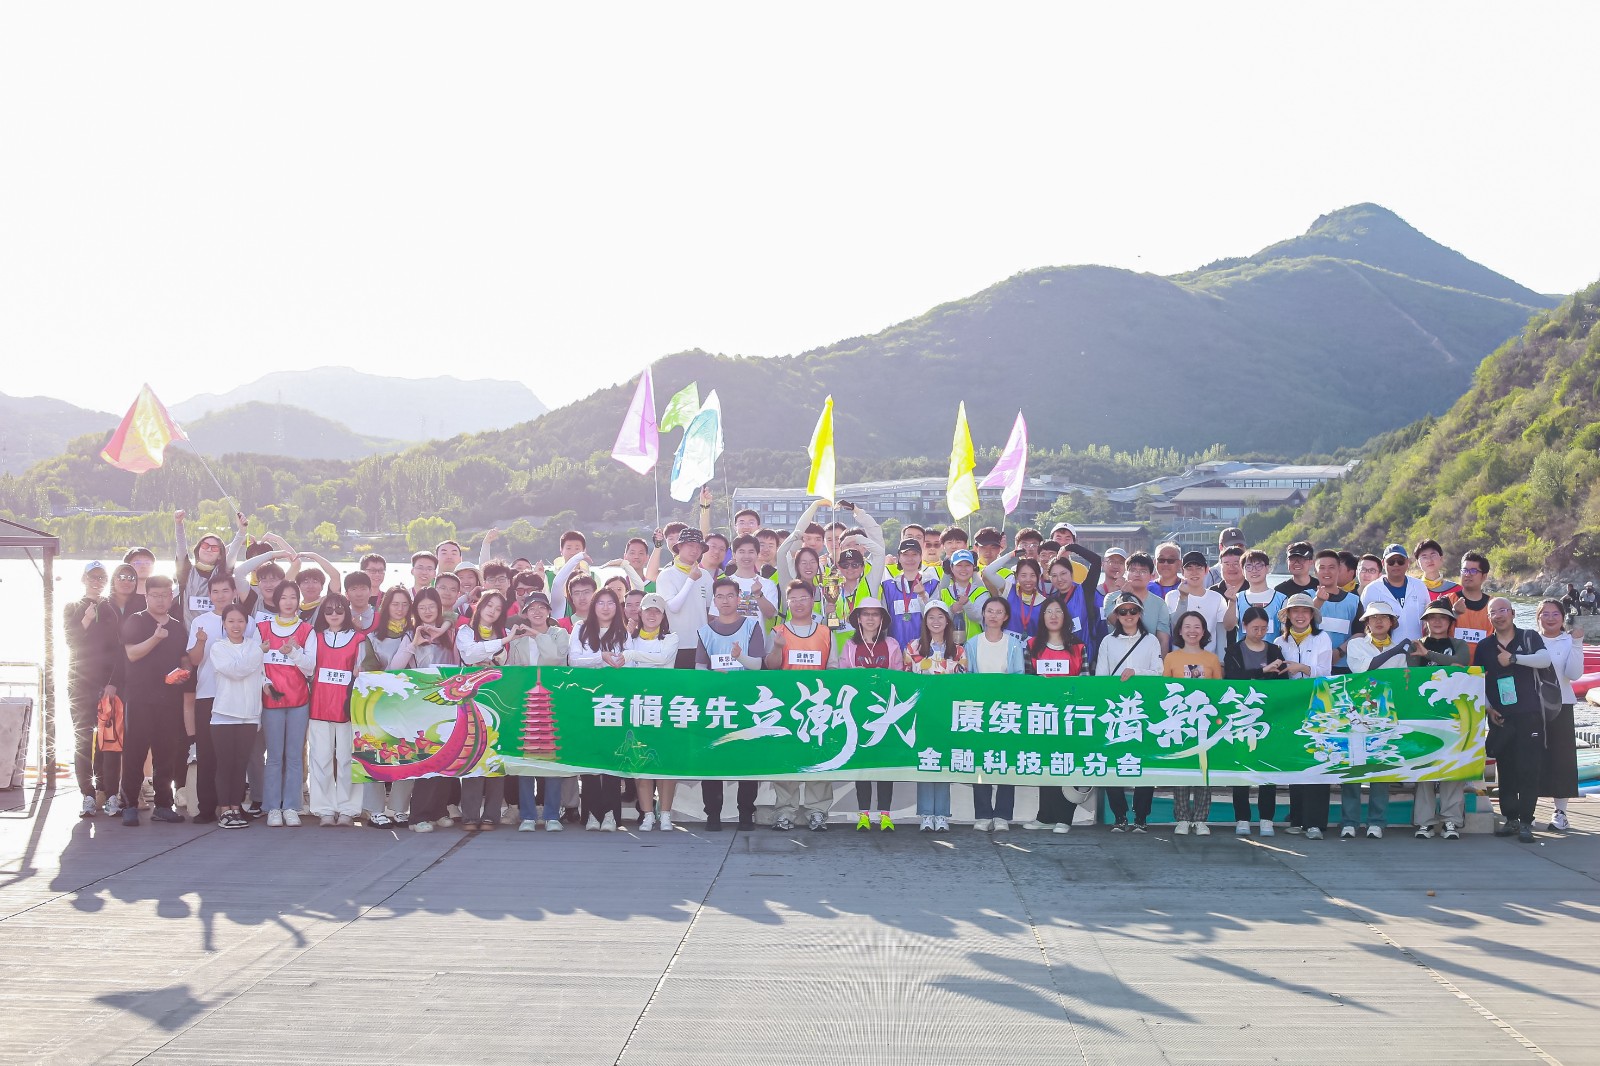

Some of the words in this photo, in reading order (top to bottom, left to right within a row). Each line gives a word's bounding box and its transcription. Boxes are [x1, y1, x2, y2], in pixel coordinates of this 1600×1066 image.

[591, 679, 921, 773] 奋楫争先立潮头
[950, 682, 1271, 785] 赓续前行谱新篇
[917, 747, 1143, 776] 金融科技部分会
